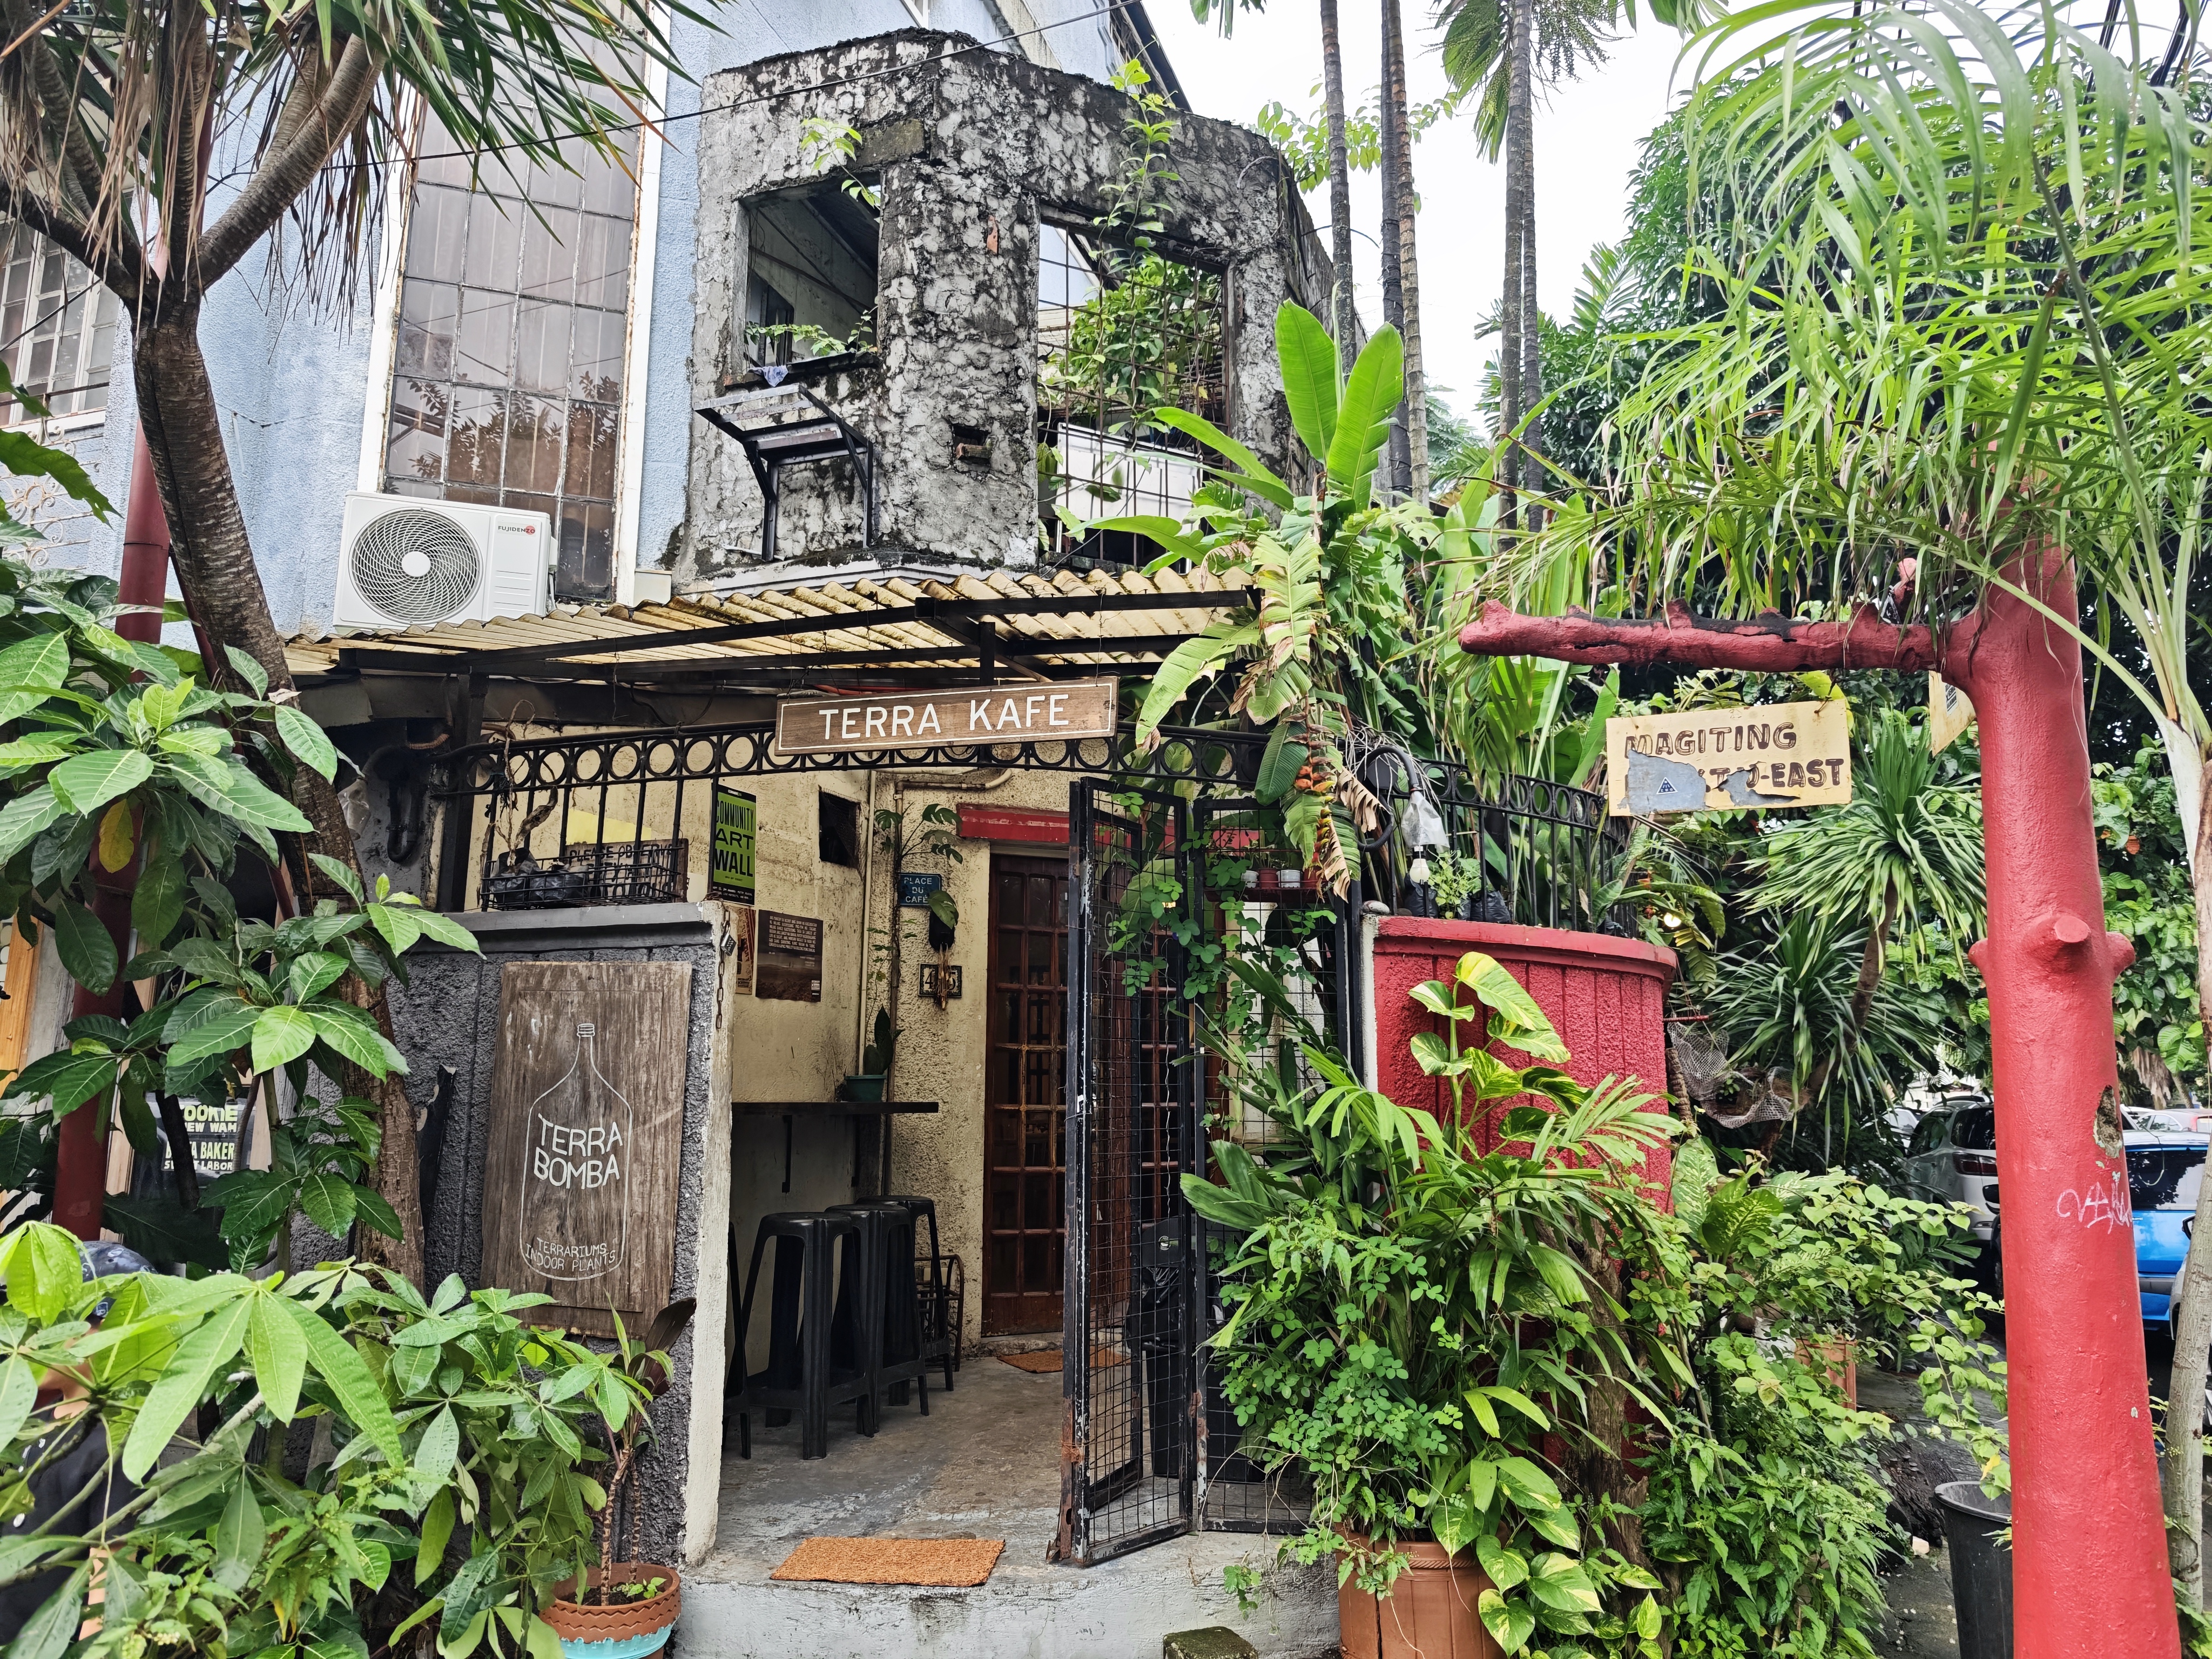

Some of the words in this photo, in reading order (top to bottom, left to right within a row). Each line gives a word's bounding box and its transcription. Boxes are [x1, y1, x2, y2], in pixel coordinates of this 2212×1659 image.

[498, 525, 535, 534] FUJIDENZO
[819, 703, 941, 740] TERRA
[969, 694, 1069, 731] KAFE
[1624, 721, 1797, 759] MAGITING
[717, 800, 754, 832] COMMUNITY
[716, 828, 754, 848] ART
[714, 848, 754, 878] WALL
[179, 1104, 238, 1122] OOKIE
[538, 1113, 623, 1157] TERRA
[201, 1161, 233, 1170] LABOR
[534, 1147, 620, 1190] BOMBA
[525, 1243, 565, 1271] INDOOR
[572, 1250, 616, 1272] PLANTS
[536, 1237, 608, 1258] TERRARIUMS
